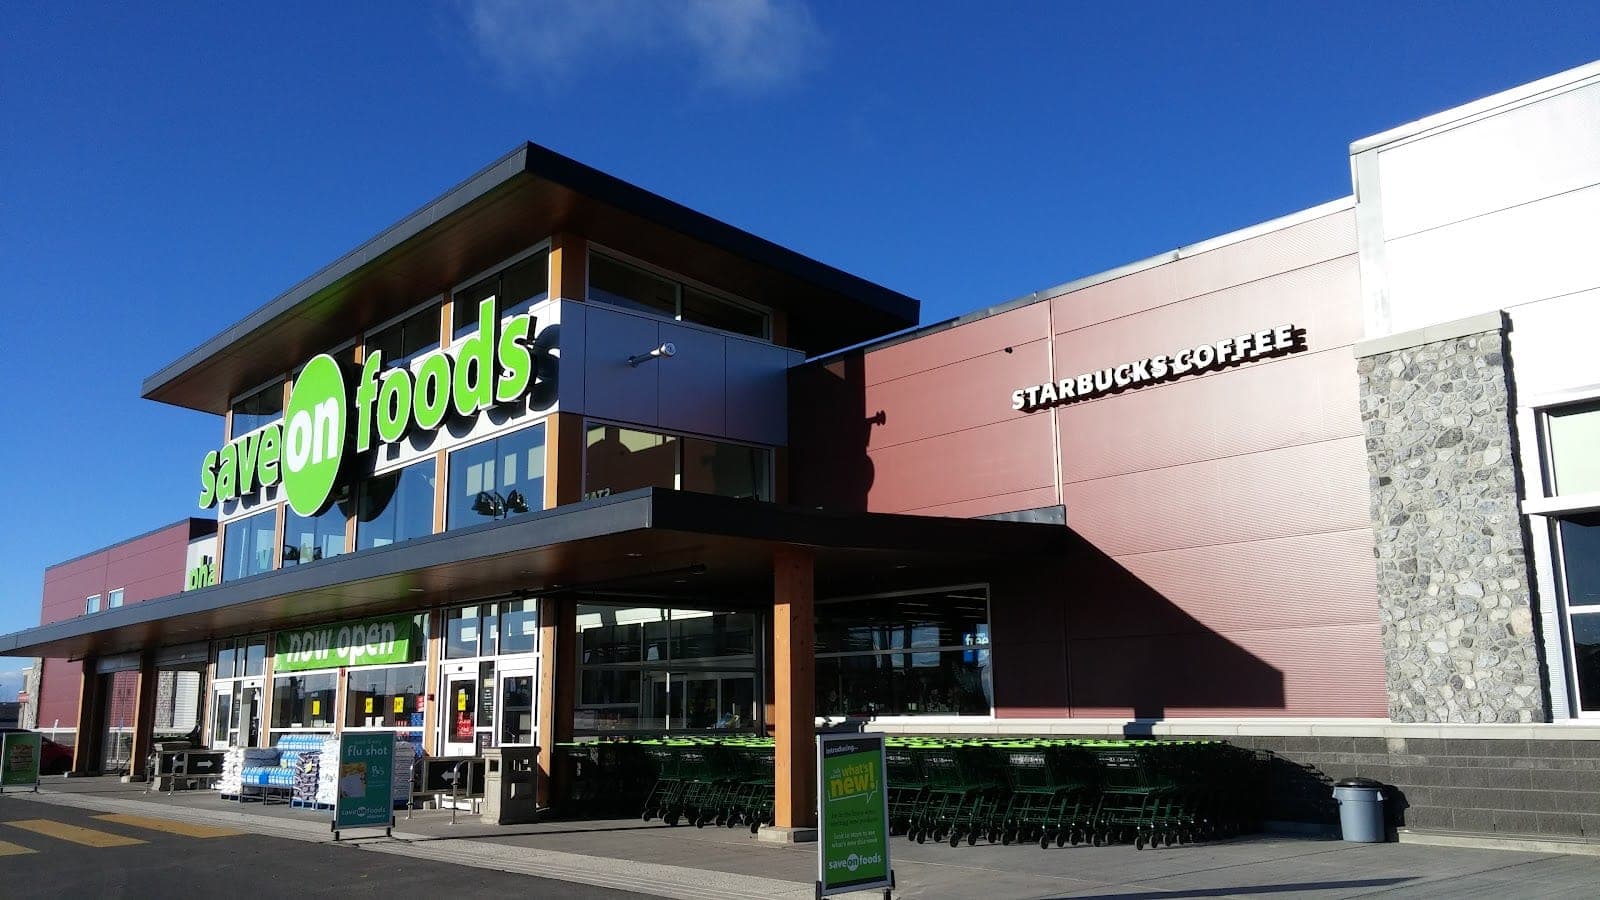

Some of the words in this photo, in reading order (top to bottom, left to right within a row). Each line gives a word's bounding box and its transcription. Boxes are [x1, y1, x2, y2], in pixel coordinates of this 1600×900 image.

[1011, 354, 1169, 410] STARBUCKS
[1170, 323, 1296, 375] COFFEE
[199, 423, 284, 509] save
[286, 395, 341, 474] on
[356, 294, 533, 454] foods
[286, 630, 331, 663] now
[337, 620, 397, 665] open
[347, 744, 363, 757] flu
[366, 743, 388, 756] shot
[842, 762, 869, 777] what's
[828, 860, 847, 870] save
[859, 853, 882, 865] foods
